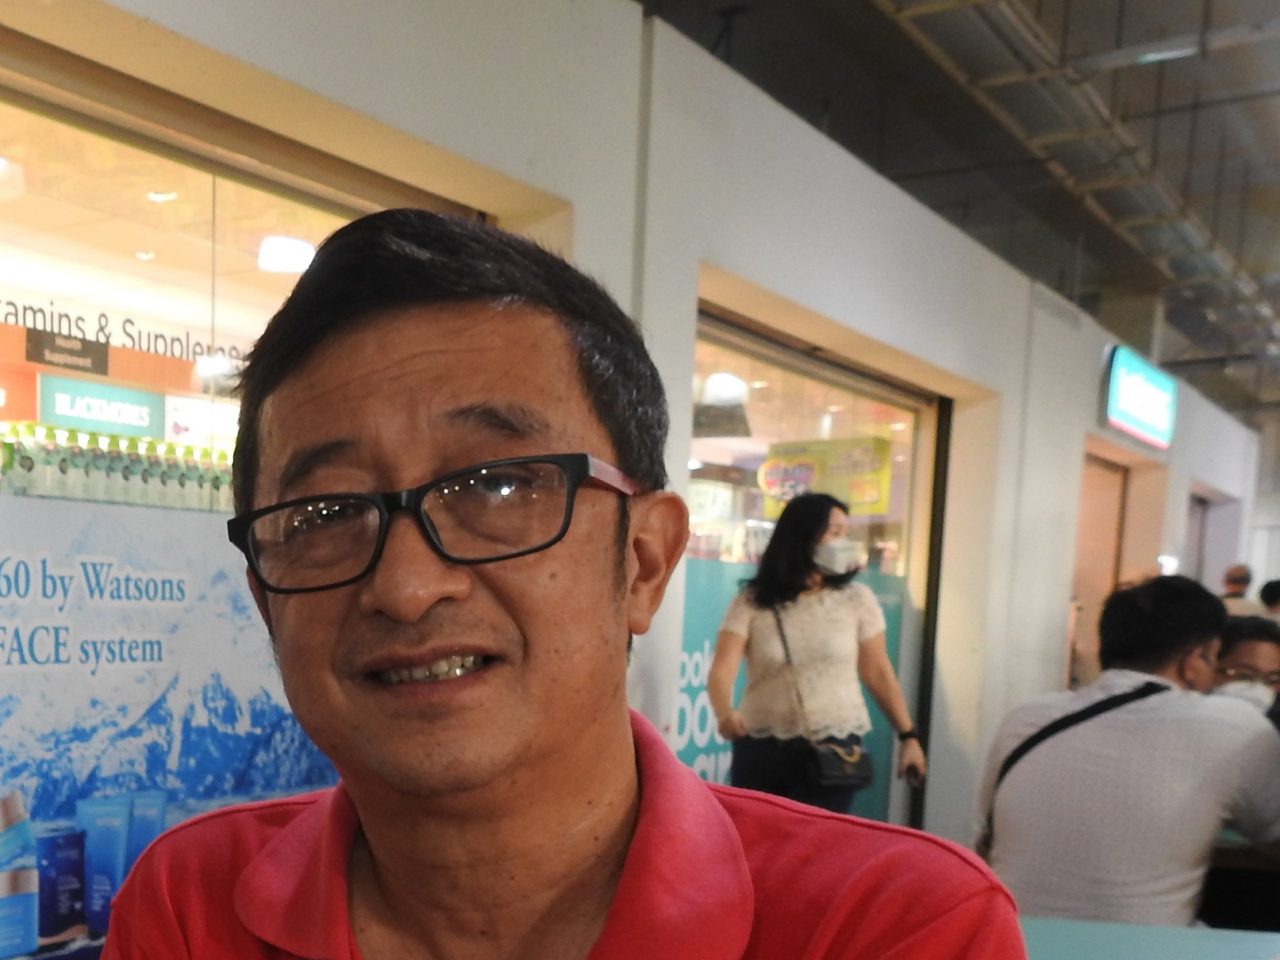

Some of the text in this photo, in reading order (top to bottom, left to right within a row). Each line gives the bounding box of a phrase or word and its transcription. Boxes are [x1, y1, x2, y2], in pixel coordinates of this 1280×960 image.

[96, 312, 112, 345] &
[41, 557, 75, 613] by
[80, 560, 187, 603] Watsons
[78, 636, 164, 676] system
